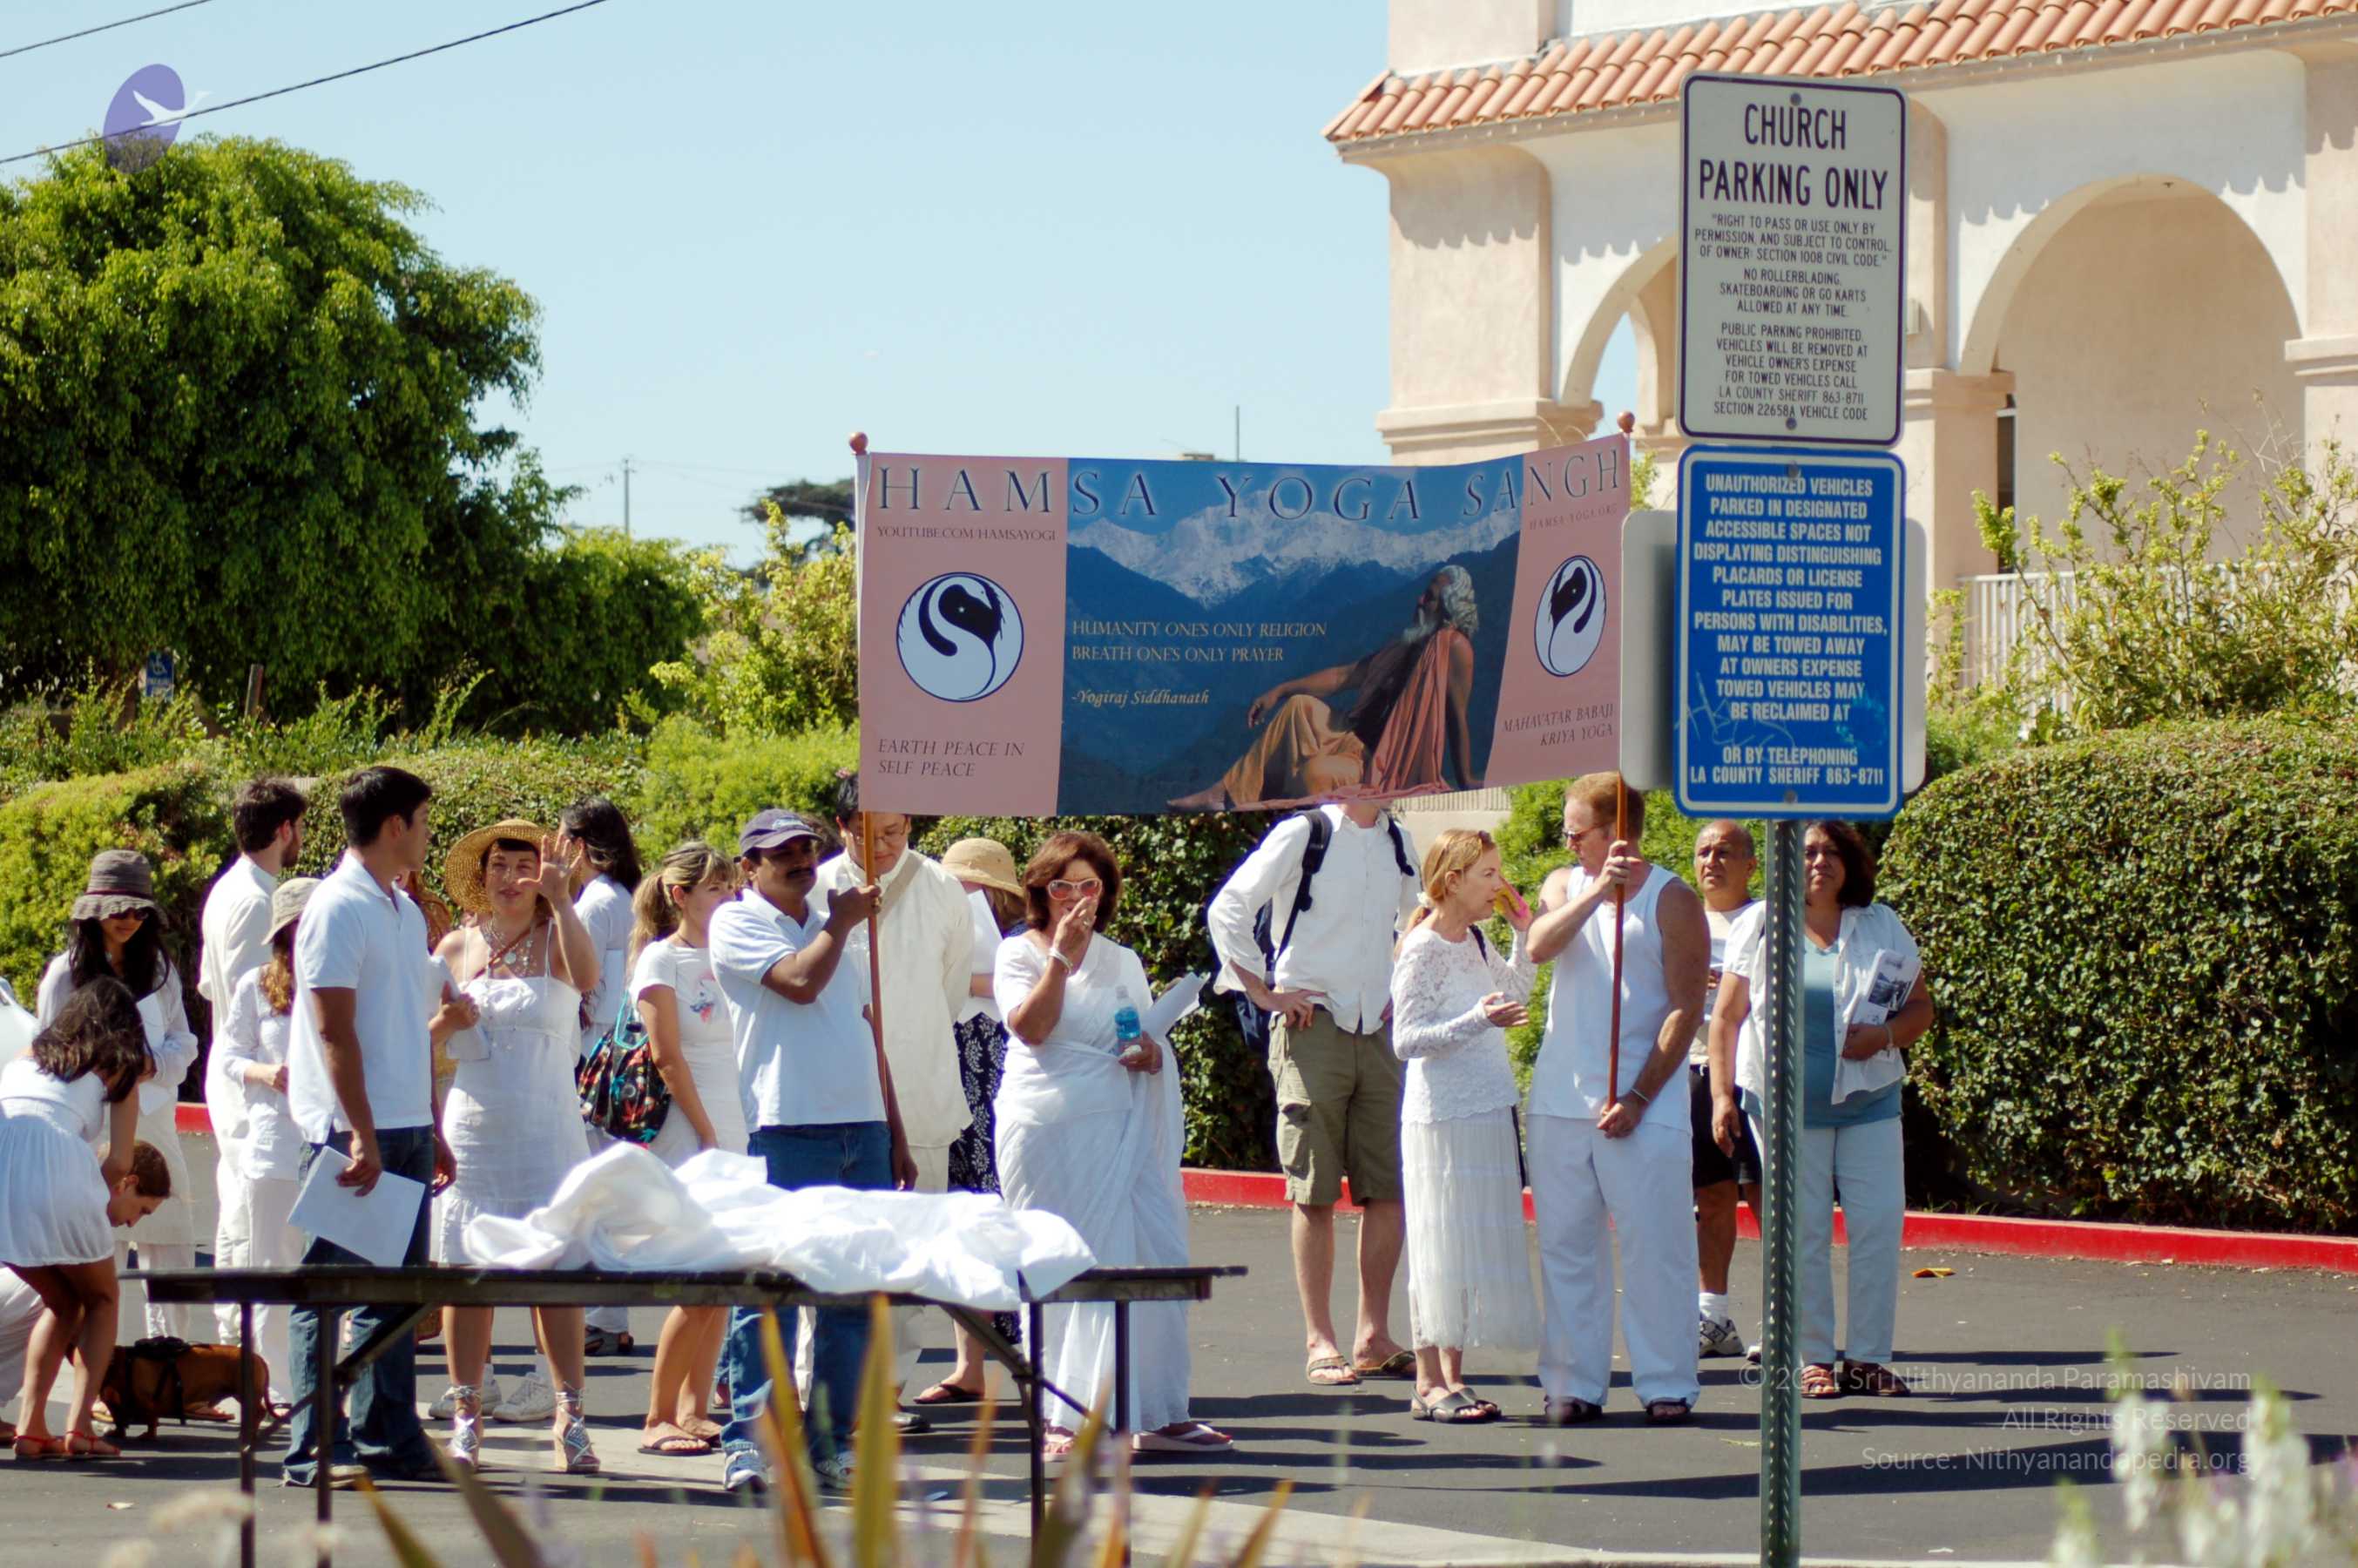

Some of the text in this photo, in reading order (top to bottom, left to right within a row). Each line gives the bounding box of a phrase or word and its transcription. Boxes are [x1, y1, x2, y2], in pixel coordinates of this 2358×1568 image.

[1745, 104, 1846, 150] CHURCH
[1700, 159, 1888, 210] PARKING ONLY
[1750, 215, 1761, 228] TO
[1765, 216, 1791, 230] PASS
[1794, 219, 1807, 231] OR
[1811, 220, 1829, 233] USE
[1834, 220, 1859, 234] ONLY
[1862, 222, 1875, 234] BY
[1760, 233, 1780, 246] AND
[1784, 233, 1826, 247] SUBJECT
[1830, 237, 1841, 249] TO
[1699, 245, 1712, 257] OF
[1757, 247, 1796, 262] SECTION
[1826, 252, 1848, 265] CIVIL
[1743, 268, 1757, 280] NO
[1720, 282, 1867, 302] SKATEBOARDING OR GO KARTS
[1737, 300, 1782, 314] ALLOWED
[1786, 301, 1797, 314] AT
[1801, 303, 1821, 315] ANY
[1721, 321, 1756, 336] PUBLIC
[1760, 324, 1802, 339] PARKING
[1716, 337, 1868, 357] VEHICLES WILL BE REMOVED AT
[1726, 355, 1857, 373] VEHICLE OWNER'S EXPENSE
[1726, 370, 1857, 389] FOR TOWED VEHICLES CALL
[1720, 385, 1864, 405] LA COUNTY SHERIFF 863-8711
[1713, 401, 1754, 416] SECTION
[1800, 405, 1839, 419] VEHICLE
[1842, 407, 1868, 420] CODE
[877, 448, 1619, 522] HAMSA YOGA SANGH
[1706, 474, 1873, 497] UNAUTHORIZED VEHICLES
[1710, 497, 1868, 519] PARKED IN DESIGNATED
[1706, 520, 1872, 542] ACCESSIBLE SPACES NOT
[1694, 543, 1882, 565] DISPLAYING DISTINGUISHING
[1713, 565, 1862, 587] PLACARDS OR LICENSE
[1722, 590, 1853, 610] PLATES ISSUED FOR
[1073, 620, 1160, 637] HUMANITY
[1213, 623, 1254, 638] ONLY
[1260, 622, 1328, 637] RELIGION
[1694, 612, 1888, 637] PERSONS WITH DISABILITIES,
[1073, 646, 1132, 660] BREATH
[1185, 647, 1226, 662] ONLY
[1232, 647, 1283, 662] PRAYER
[1718, 635, 1865, 655] MAY BE TOWED AWAY
[1720, 657, 1861, 677] AT OWNERS EXPENSE
[1131, 689, 1209, 705] Siddhanath
[1716, 679, 1865, 700] TOWED VEHICLES MAY
[1731, 703, 1850, 721] BE RECLAIMED AT
[1540, 723, 1613, 746] KRIYA YOGA
[878, 739, 1024, 757] EARTH PEACE IN
[1723, 747, 1858, 766] OR BY TELEPHONING
[878, 760, 976, 777] SELF PEACE
[1691, 767, 1883, 785] LA COUNTY SHERIFF 863-8711
